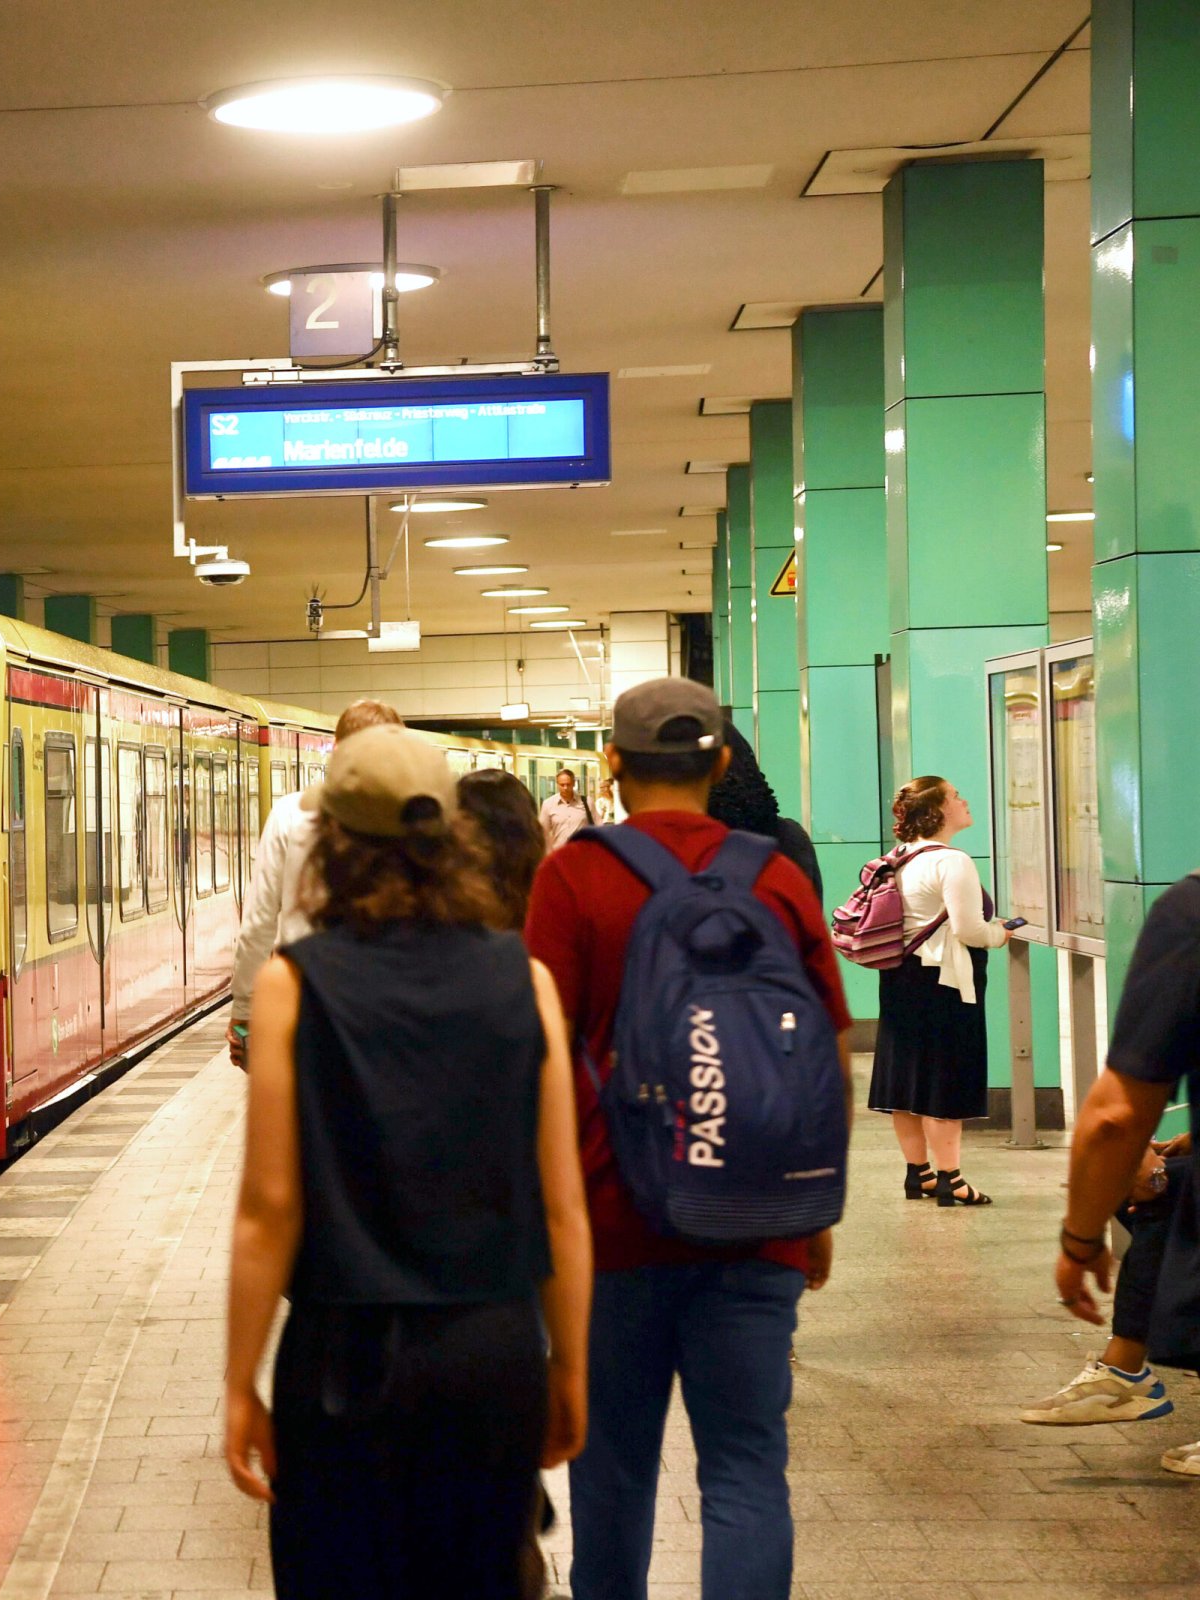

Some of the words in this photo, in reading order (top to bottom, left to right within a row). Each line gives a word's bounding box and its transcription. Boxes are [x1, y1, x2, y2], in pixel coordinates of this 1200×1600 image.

[305, 275, 340, 330] 2
[211, 414, 239, 436] S2
[284, 437, 409, 462] Marienfelde
[688, 1004, 727, 1168] PASSION
